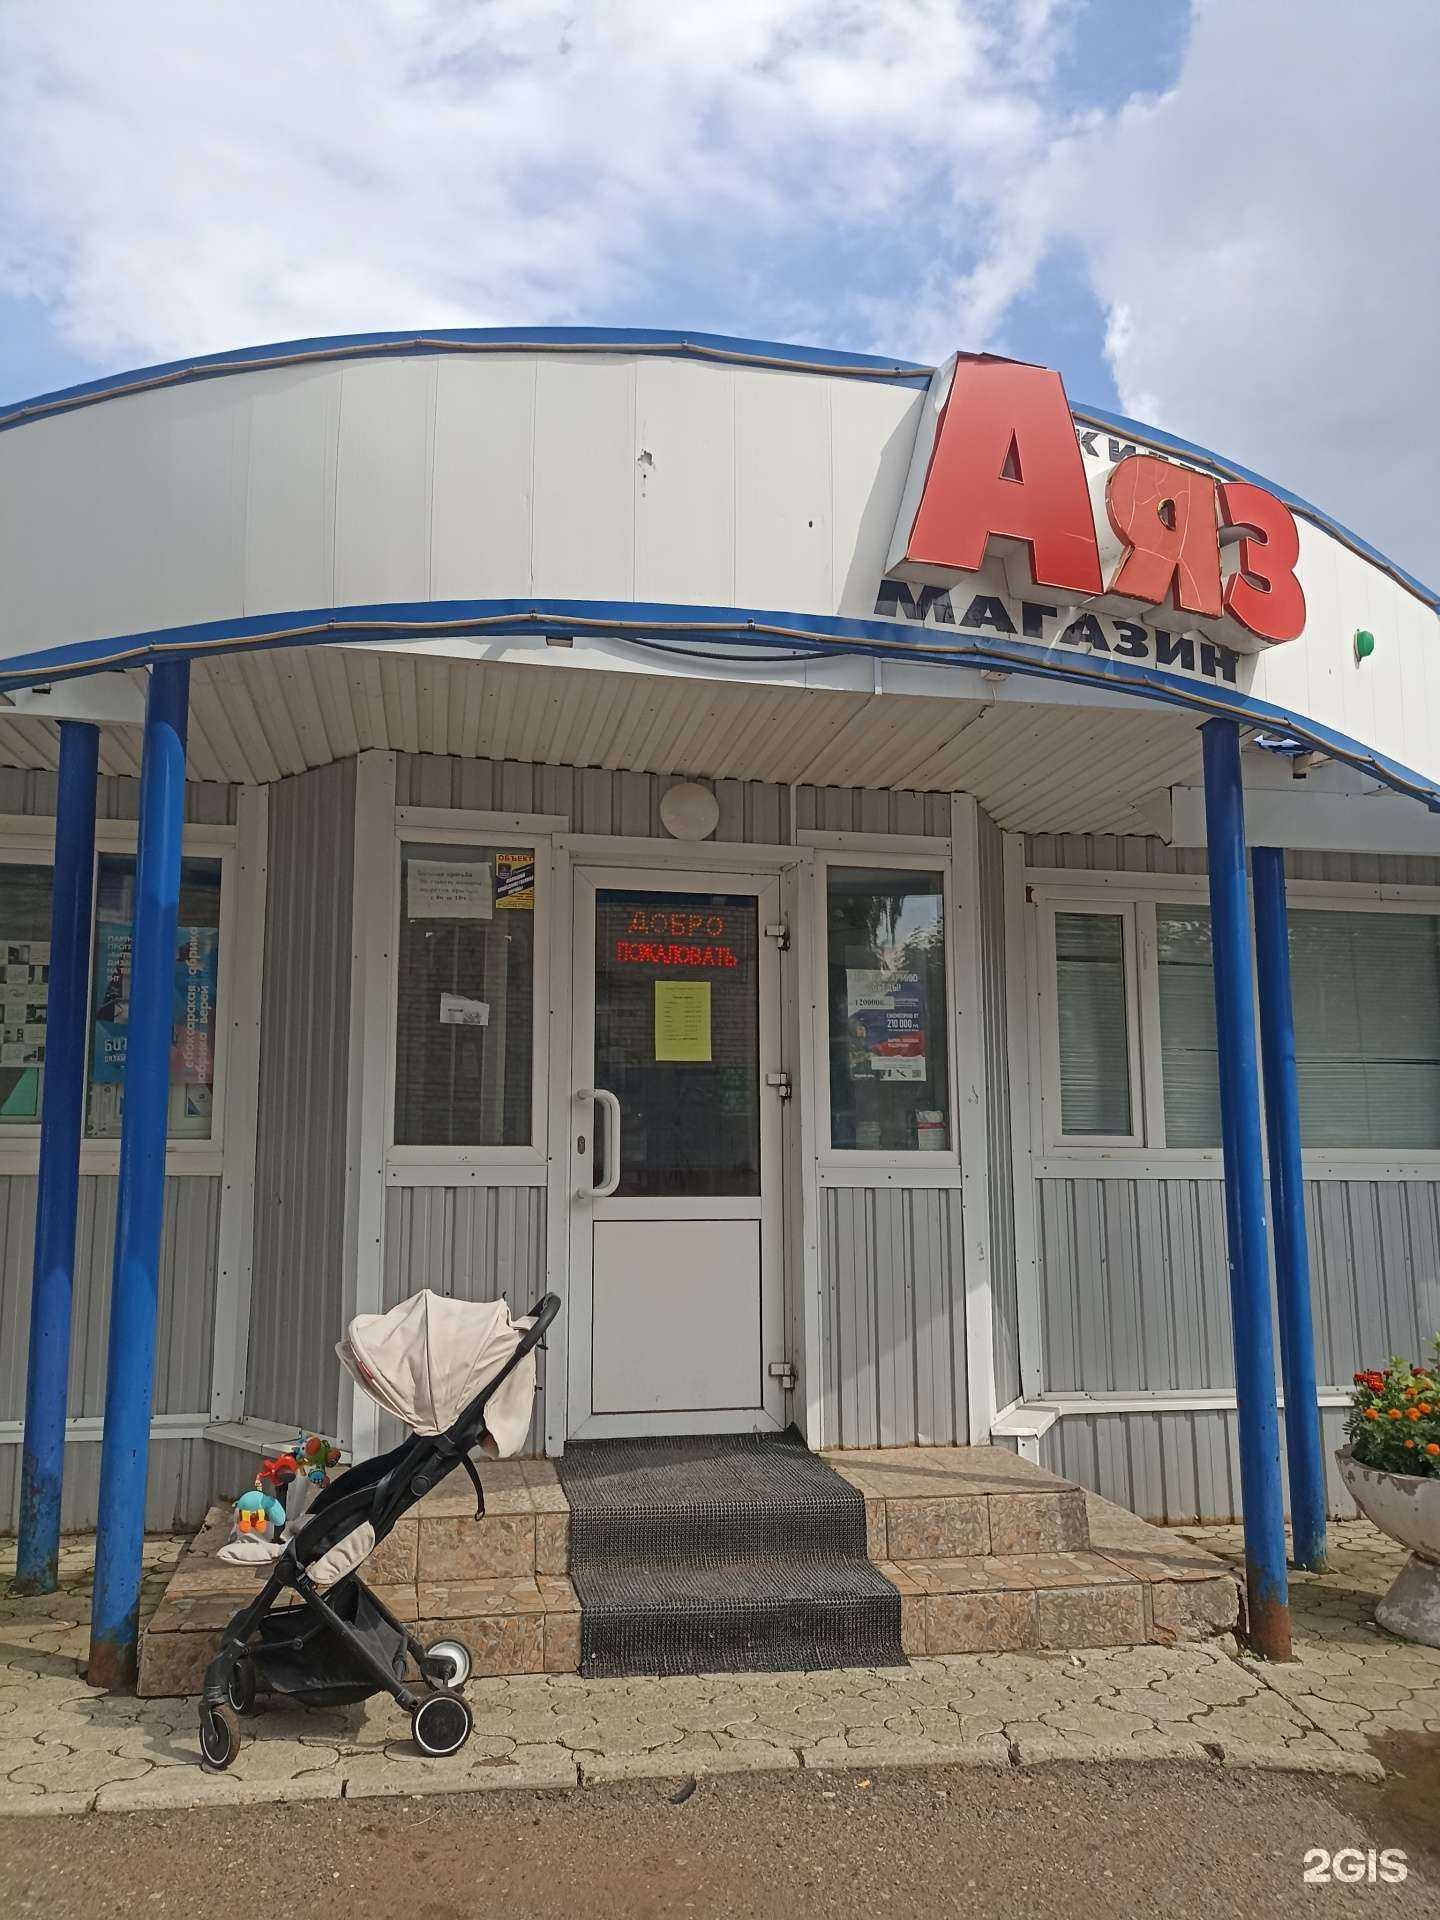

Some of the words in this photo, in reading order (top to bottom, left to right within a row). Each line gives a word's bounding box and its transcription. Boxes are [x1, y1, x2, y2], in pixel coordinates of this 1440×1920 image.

[890, 352, 1306, 643] АЯЗ
[874, 579, 1238, 684] МАГАЗИН
[615, 940, 738, 968] ПОЖАЛОВАТЬ
[627, 911, 725, 937] ДОБРО
